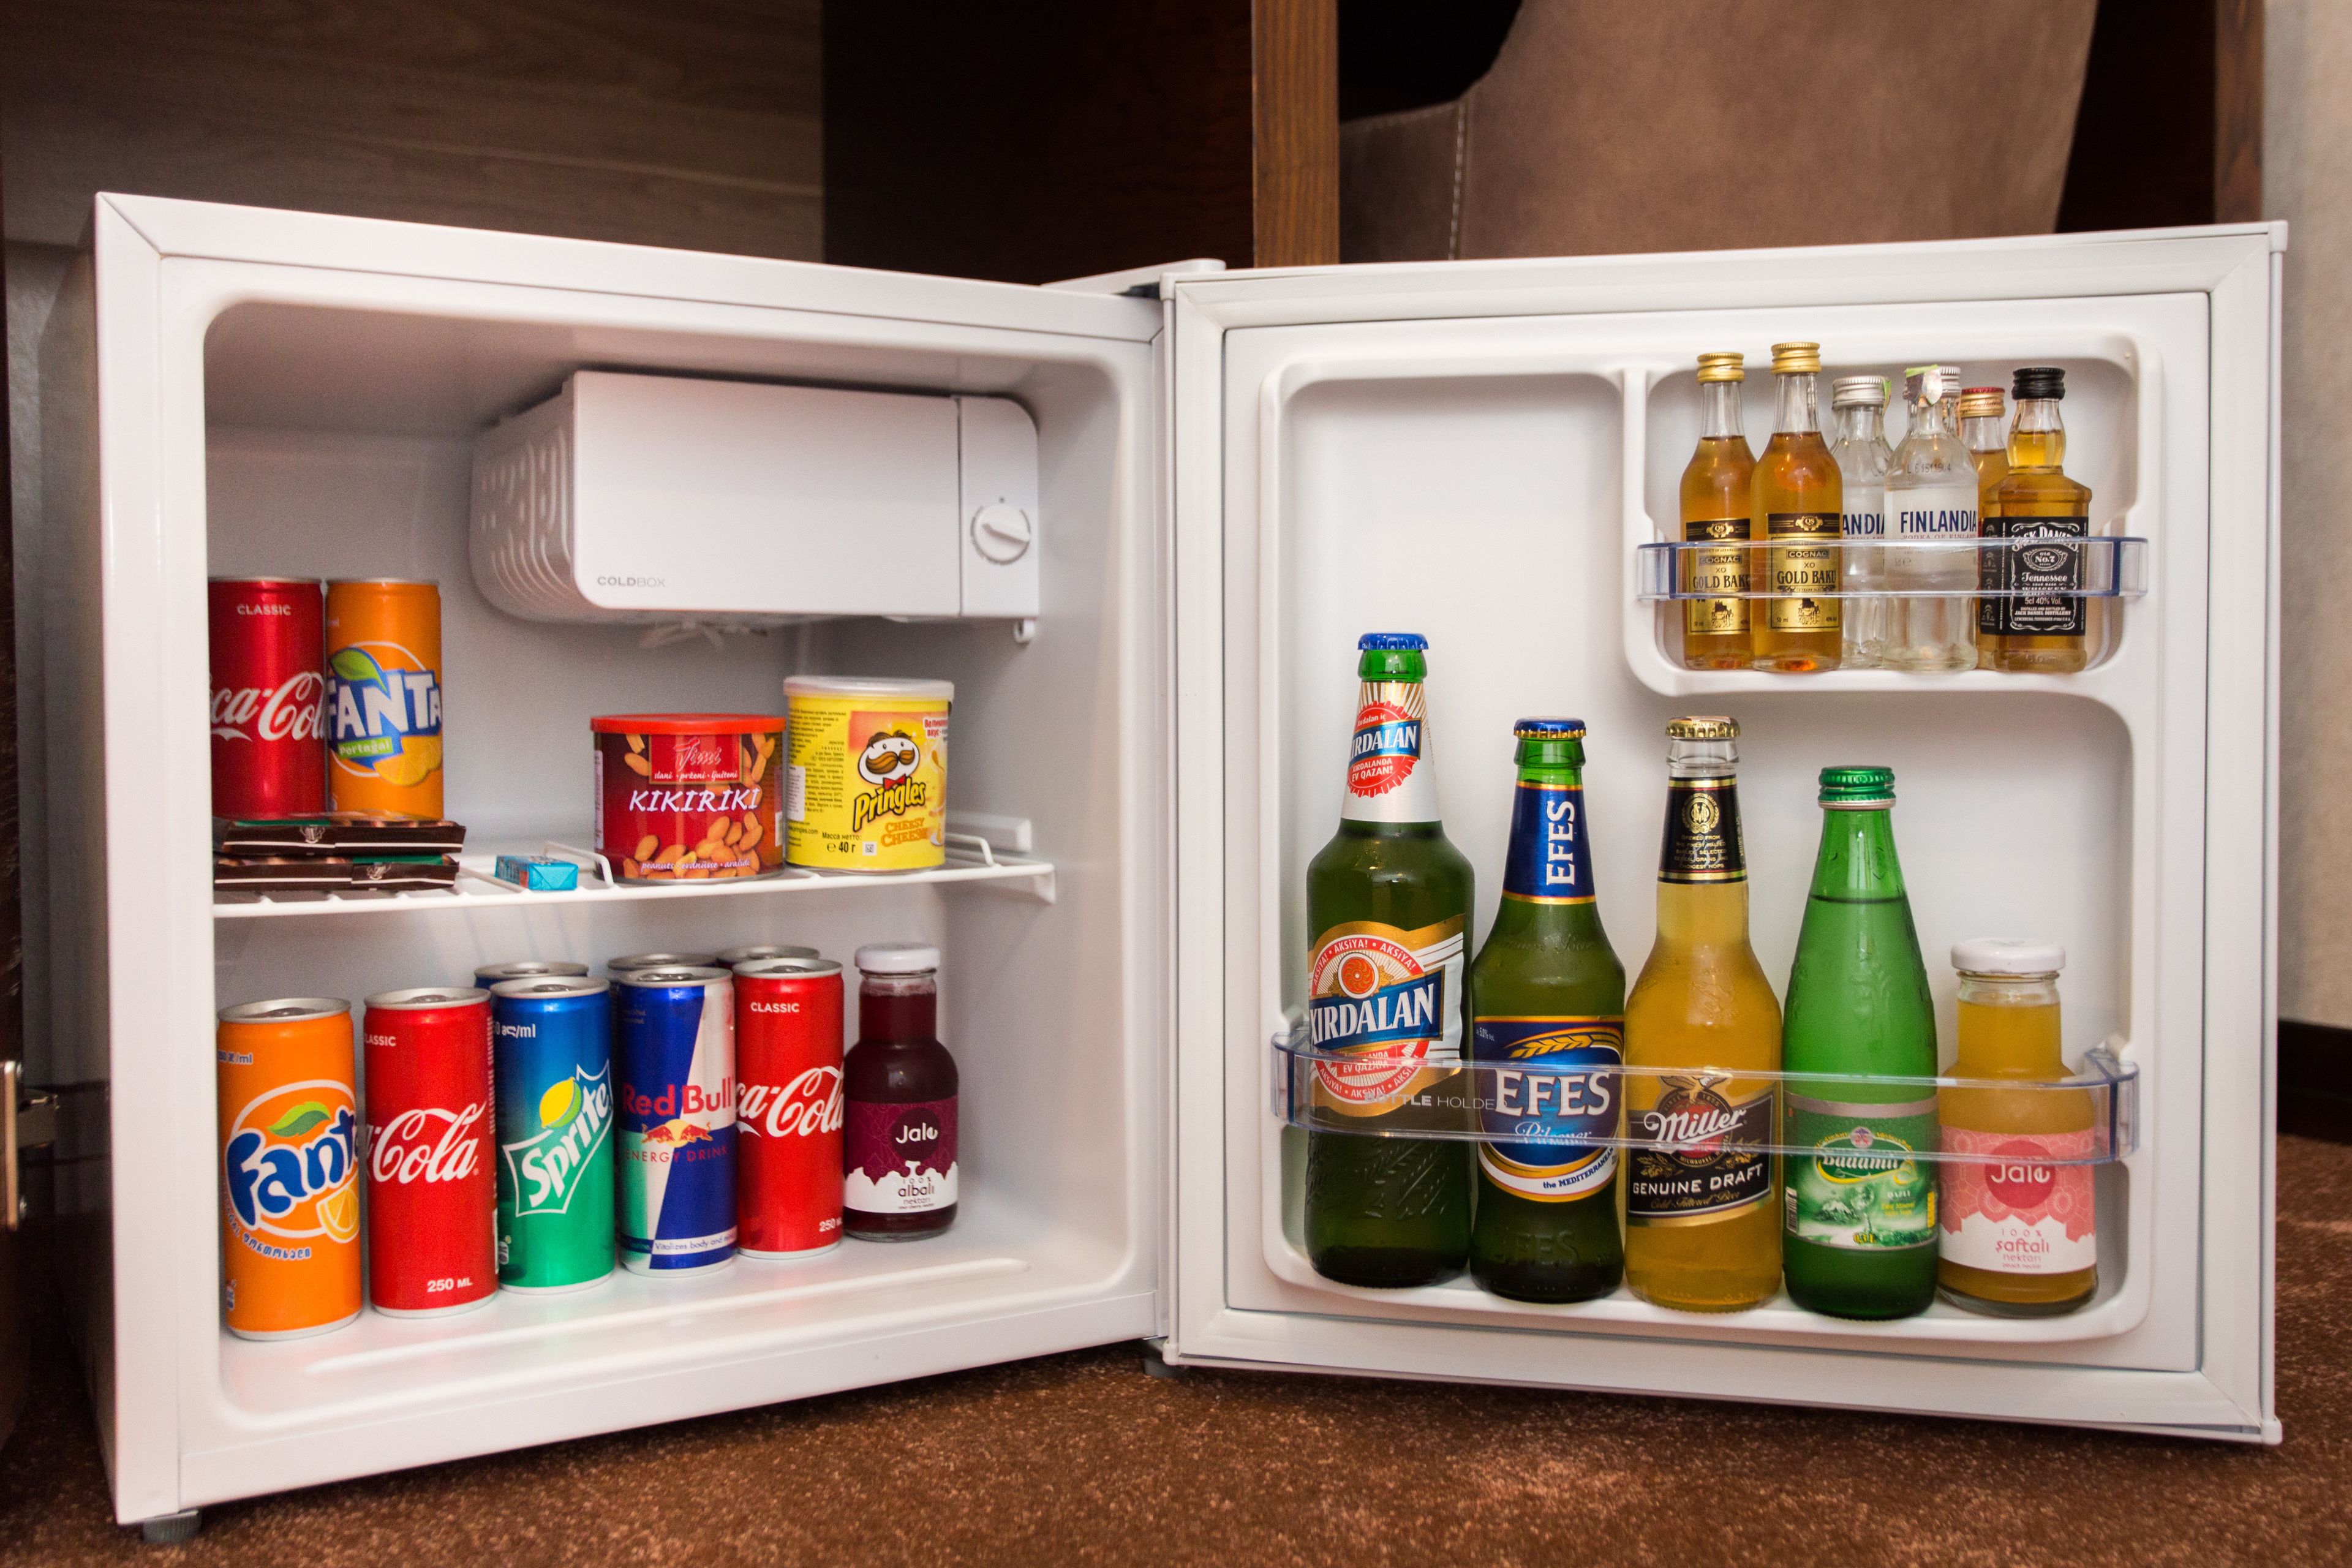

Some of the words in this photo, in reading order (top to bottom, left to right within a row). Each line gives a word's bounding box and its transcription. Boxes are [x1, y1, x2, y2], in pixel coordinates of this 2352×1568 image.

[1901, 510, 1977, 533] FINLANDIA
[597, 576, 666, 587] COLDBOX
[1693, 576, 1721, 589] GOLD
[1724, 575, 1749, 588] BAK
[1777, 571, 1808, 584] GOLD
[1812, 570, 1836, 584] BAKU
[2021, 572, 2068, 582] Tennessee
[236, 604, 292, 615] CLASSIC
[1351, 726, 1417, 760] IRDALAN
[1352, 773, 1359, 783] EV
[1360, 765, 1393, 780] QAZAN!
[629, 788, 761, 812] KIKIRIKI
[853, 775, 927, 833] Pringles
[839, 842, 848, 853] 40
[1546, 801, 1575, 886] EFES
[750, 1001, 799, 1014] CLASSIC
[365, 1035, 396, 1047] LASSIC
[622, 1084, 675, 1116] Red
[682, 1077, 731, 1114] Bull
[1495, 1068, 1610, 1117] EFES
[1644, 1109, 1747, 1145] Miller
[521, 1082, 611, 1207] Sprite
[624, 1148, 680, 1163] ENERGY
[227, 1109, 356, 1226] Fant
[1633, 1179, 1702, 1196] GENUINE
[1709, 1163, 1763, 1191] DRAFT
[819, 1218, 835, 1232] 250
[428, 1278, 453, 1293] 250
[457, 1278, 472, 1288] ML
